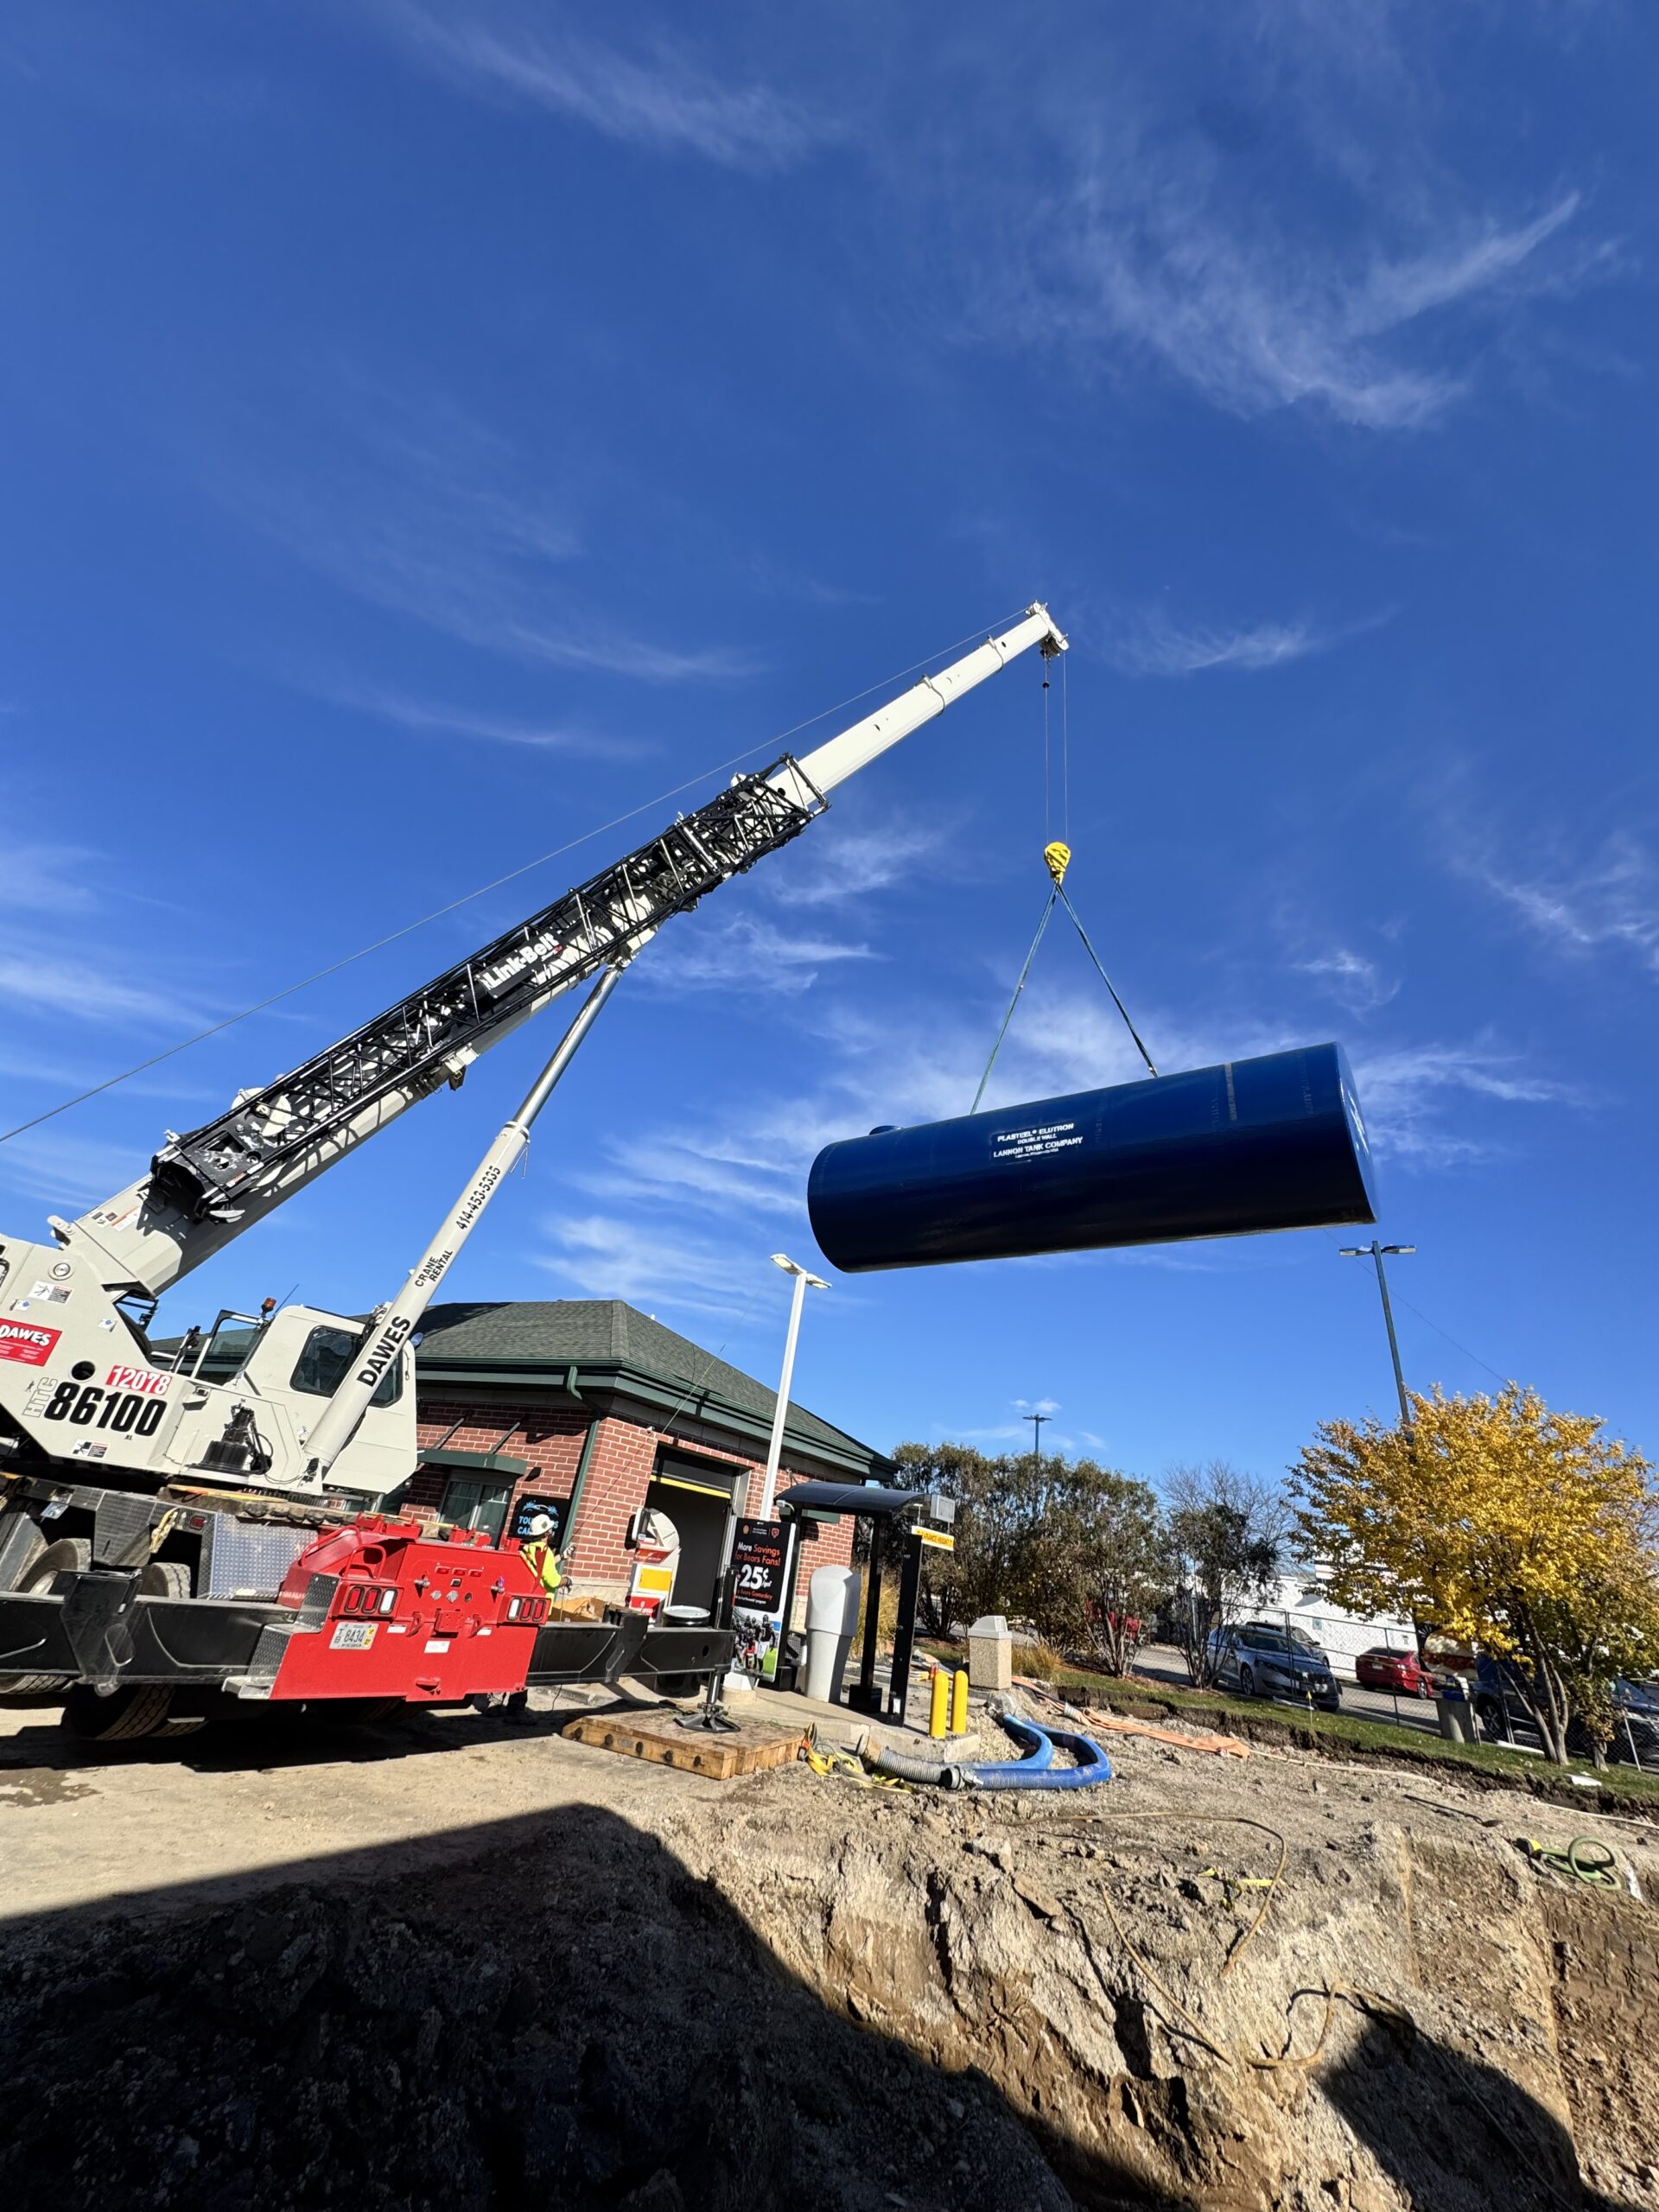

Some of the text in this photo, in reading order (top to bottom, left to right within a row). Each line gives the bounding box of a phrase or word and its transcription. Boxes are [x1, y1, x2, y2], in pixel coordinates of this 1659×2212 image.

[481, 932, 560, 990] Link-Belt
[1018, 1136, 1040, 1145] DOUBLE
[1039, 1123, 1074, 1135] ELUTRON
[994, 1147, 1023, 1158] LANNON
[1024, 1143, 1044, 1152] TANK
[1045, 1136, 1083, 1149] COMPANY
[415, 1256, 439, 1287] CRANE
[429, 1250, 454, 1282] RENTAL
[0, 1324, 52, 1346] DAWES
[356, 1316, 410, 1388] DAWES
[109, 1366, 172, 1396] 12078
[22, 1376, 59, 1419] HTC
[44, 1382, 168, 1437] 86100
[738, 1541, 780, 1557] More Savings
[743, 1552, 760, 1563] Bears
[761, 1555, 781, 1566] Fans!
[344, 1630, 365, 1643] 8434
